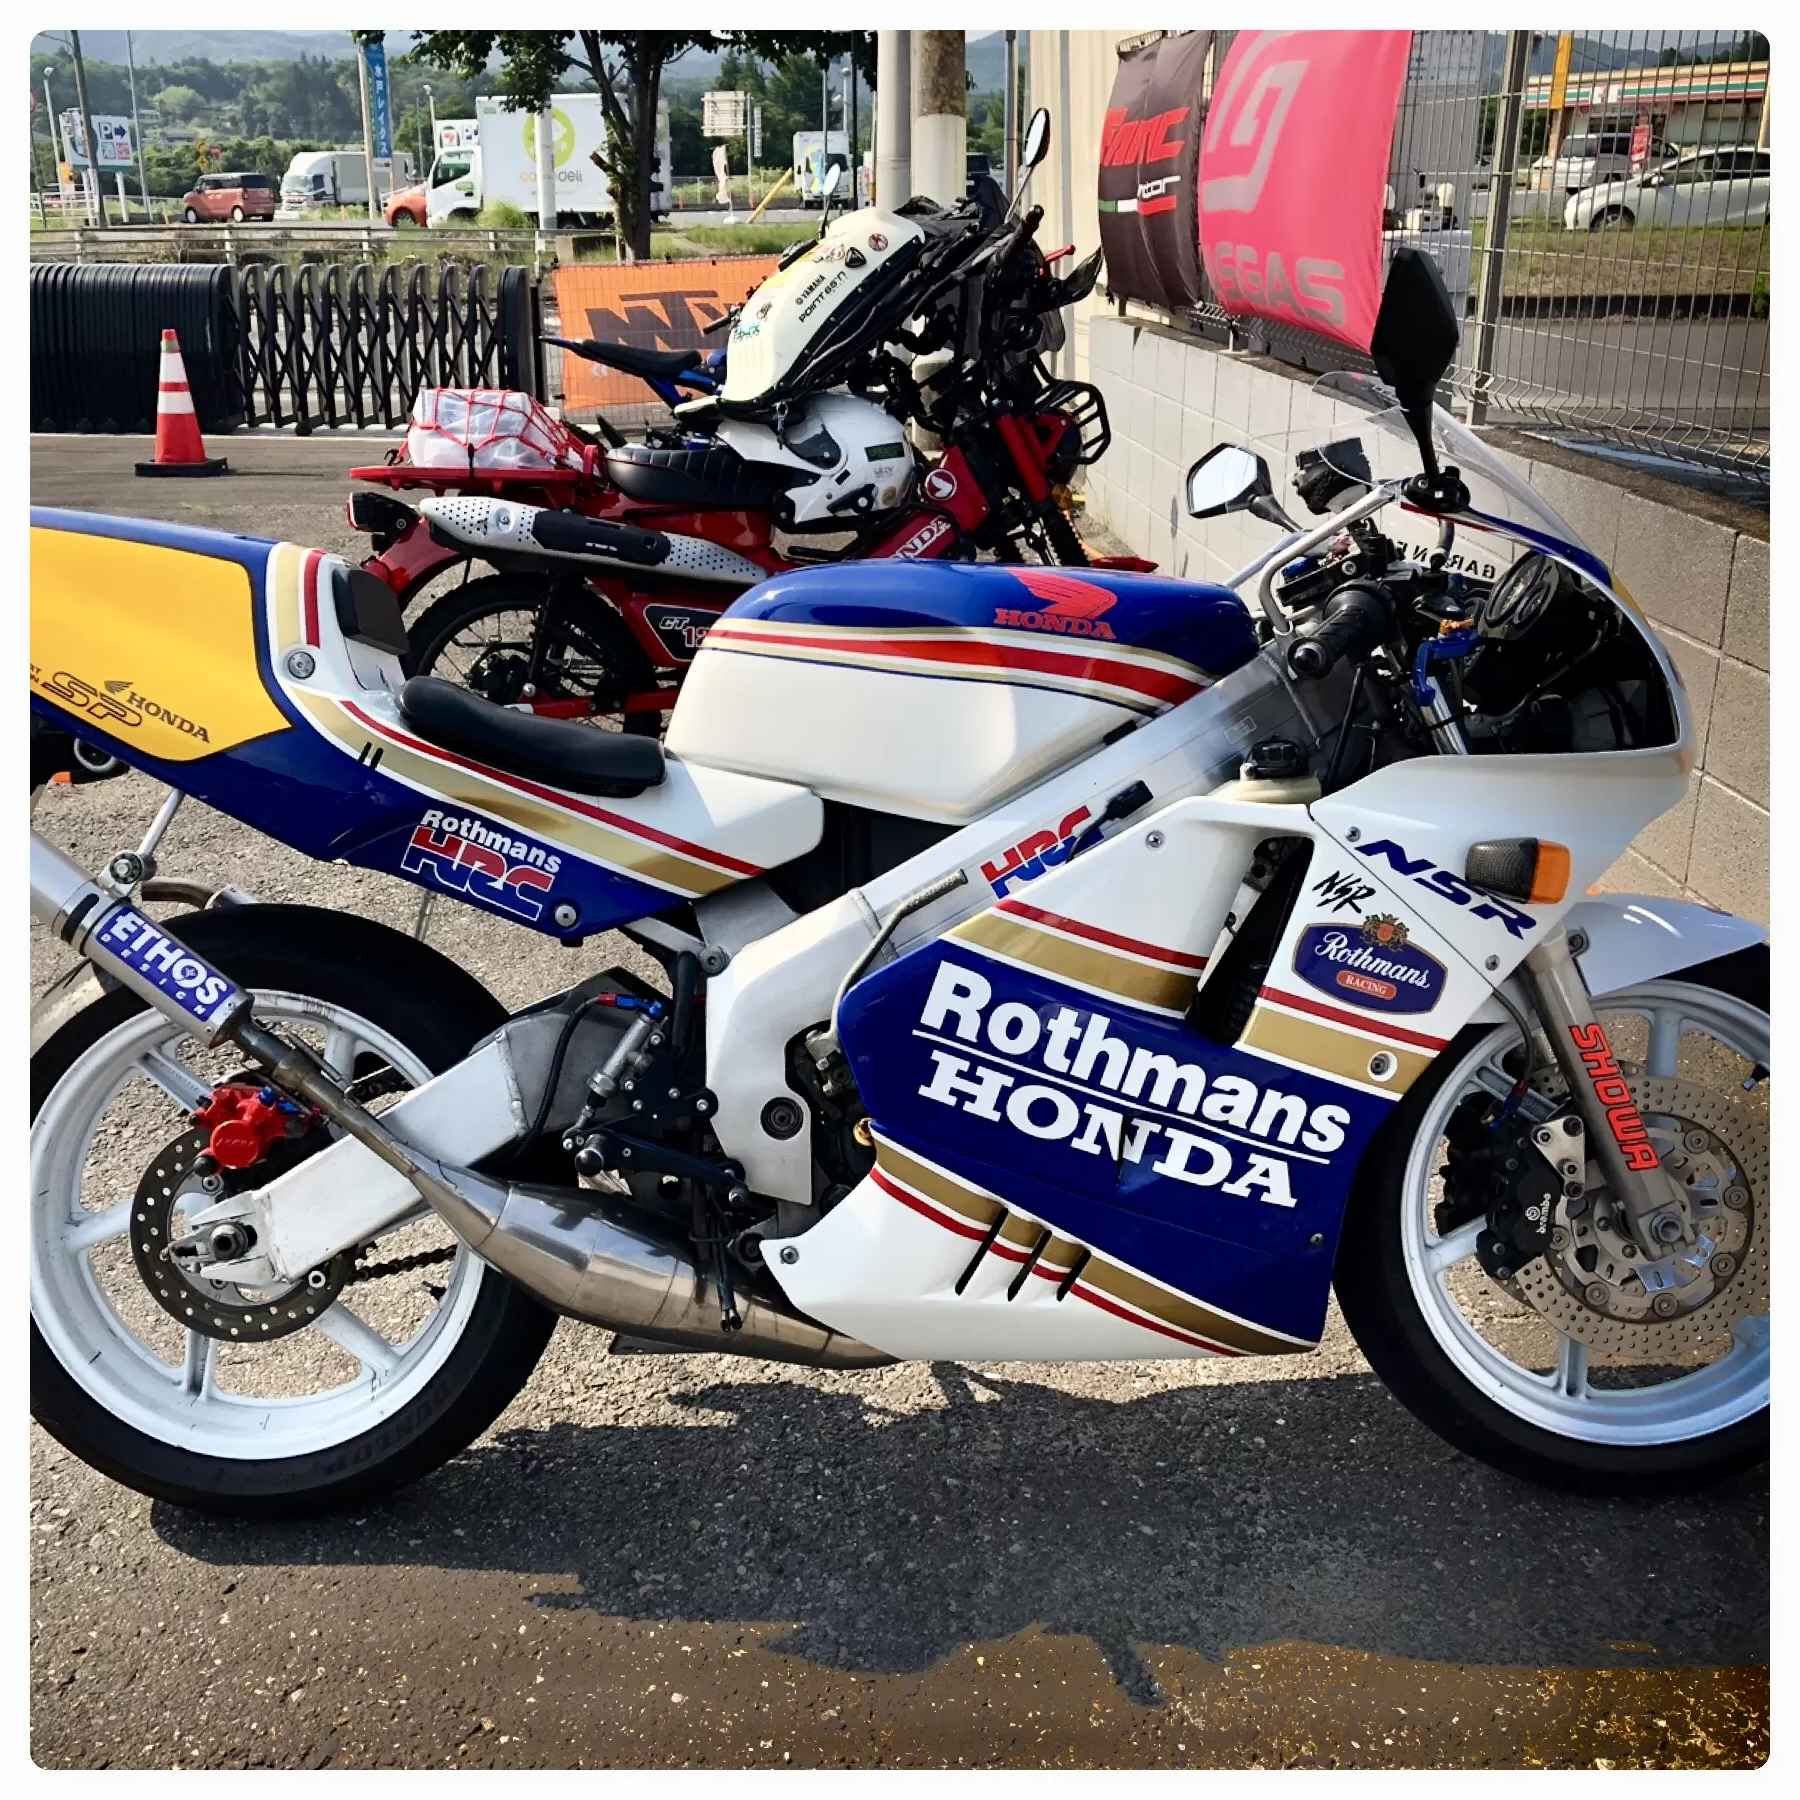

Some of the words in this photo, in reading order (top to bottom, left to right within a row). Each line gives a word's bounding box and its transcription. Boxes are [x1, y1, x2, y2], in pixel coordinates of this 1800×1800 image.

[373, 63, 389, 156] 水戸レイクス
[558, 168, 582, 182] deli
[801, 274, 826, 301] YAMAHA
[659, 616, 691, 630] CT
[682, 625, 709, 648] 12
[995, 607, 1117, 640] HONDA
[41, 671, 143, 726] SP
[126, 691, 211, 744] HONDA
[420, 809, 562, 874] Rothmans
[980, 804, 1105, 900] HRC
[400, 825, 556, 922] HRC
[1312, 870, 1377, 914] NSR
[1354, 838, 1537, 941] NSR
[100, 933, 207, 1015] DESIGN
[110, 911, 228, 1005] ETHOS
[1315, 930, 1432, 989] Rothmans
[1345, 973, 1388, 996] RACING
[920, 960, 1352, 1155] Rothmans
[1568, 1022, 1660, 1172] SHOWA
[918, 1049, 1299, 1209] HONDA
[1535, 1191, 1552, 1235] brembo
